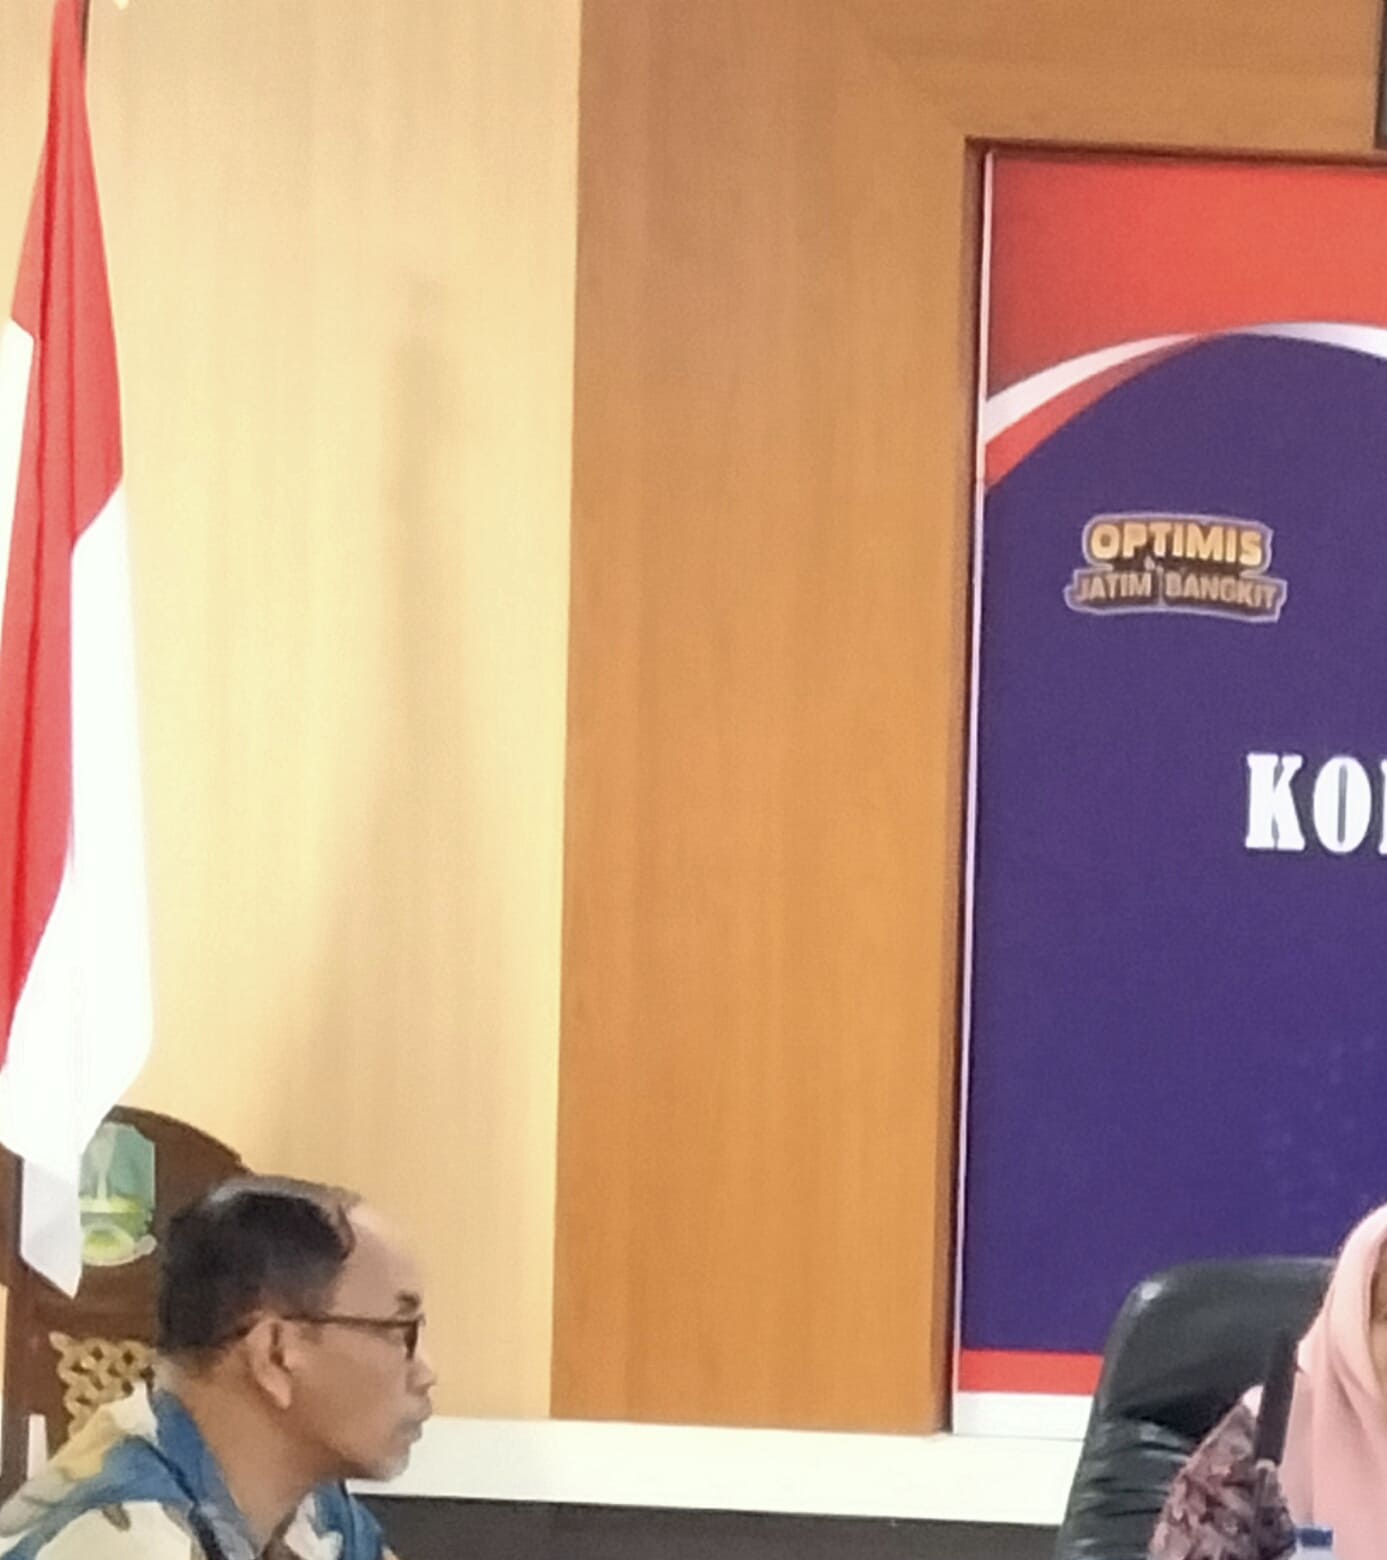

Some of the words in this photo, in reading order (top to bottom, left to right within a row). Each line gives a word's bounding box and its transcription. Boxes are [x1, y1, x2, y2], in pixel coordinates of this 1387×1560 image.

[1090, 522, 1263, 567] OPTIMIS
[1075, 571, 1151, 601] JATIM
[1165, 570, 1277, 609] BANGKIT
